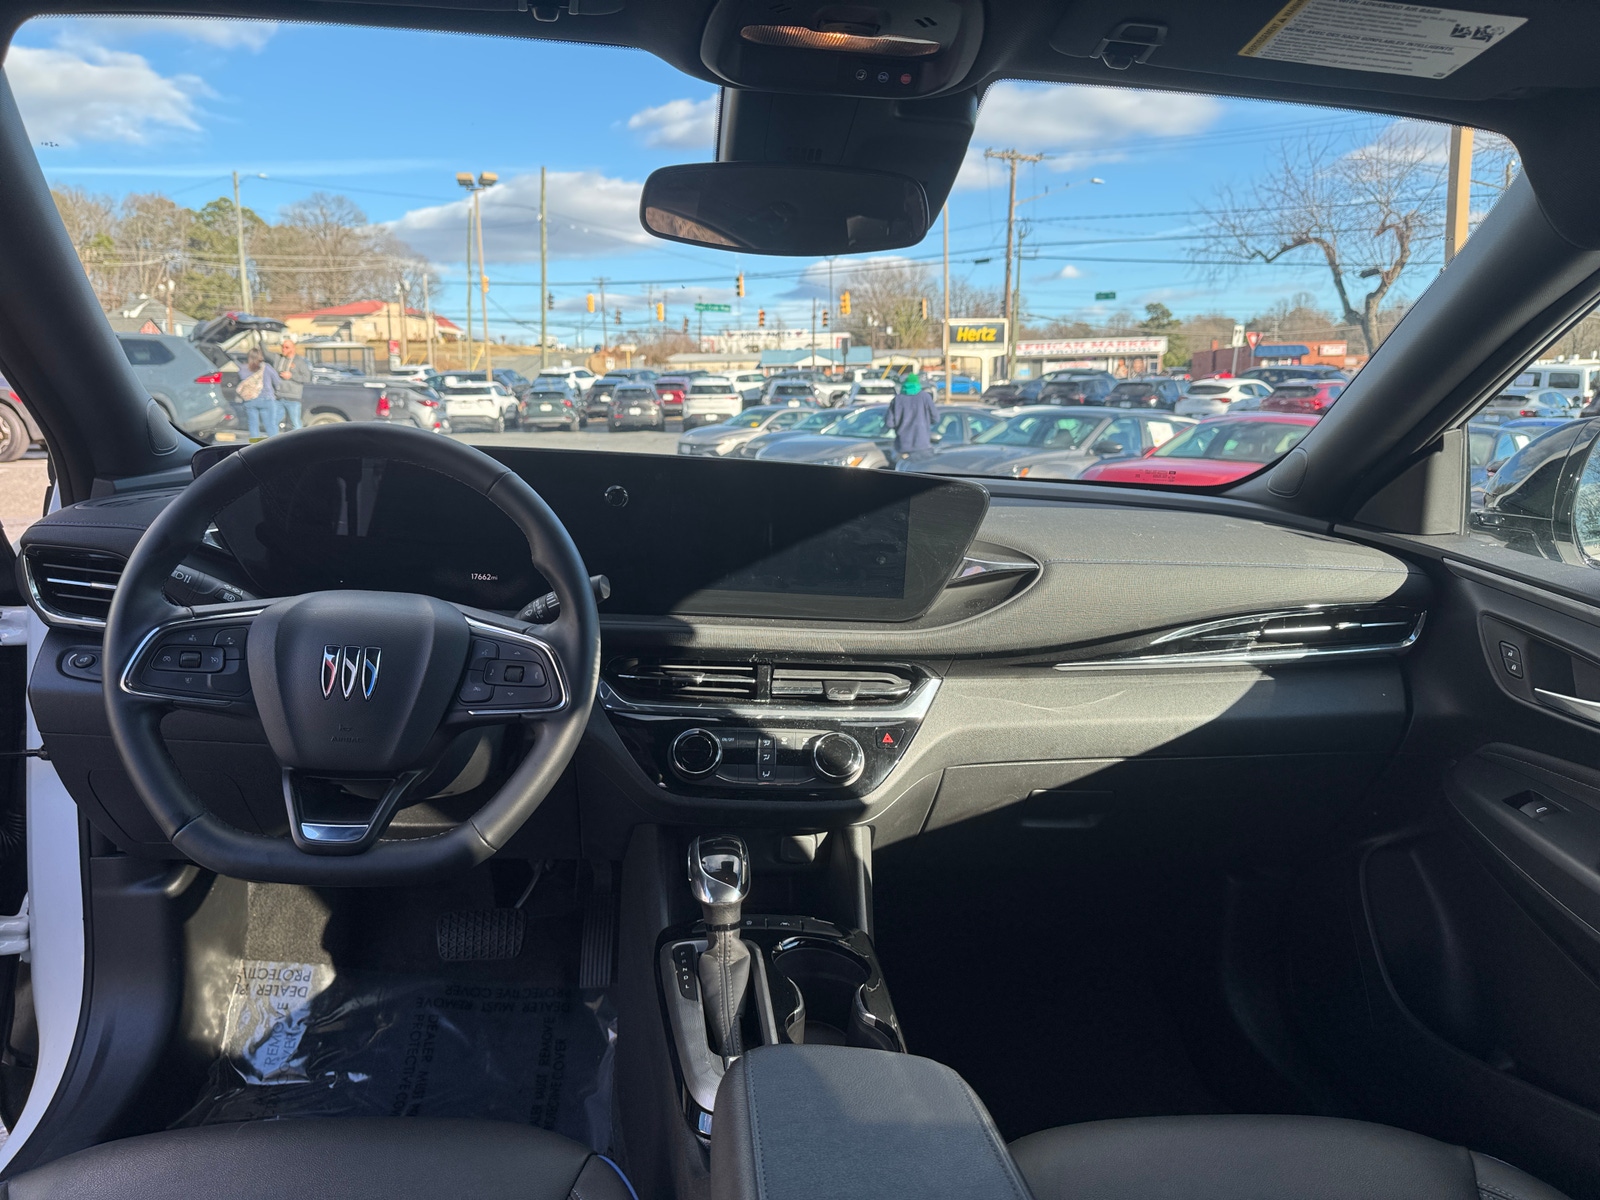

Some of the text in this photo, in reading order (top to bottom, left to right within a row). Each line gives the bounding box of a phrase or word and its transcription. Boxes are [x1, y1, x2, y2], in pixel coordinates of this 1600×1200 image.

[956, 326, 997, 342] Hertz
[1091, 339, 1162, 348] MARKET
[257, 984, 308, 998] DEALER
[445, 984, 492, 997] COVER
[416, 997, 571, 1013] DEALER MUST REMOVE
[264, 1002, 289, 1067] REMOVE
[421, 1014, 439, 1063] DEALER
[538, 1017, 555, 1067] REMOVE
